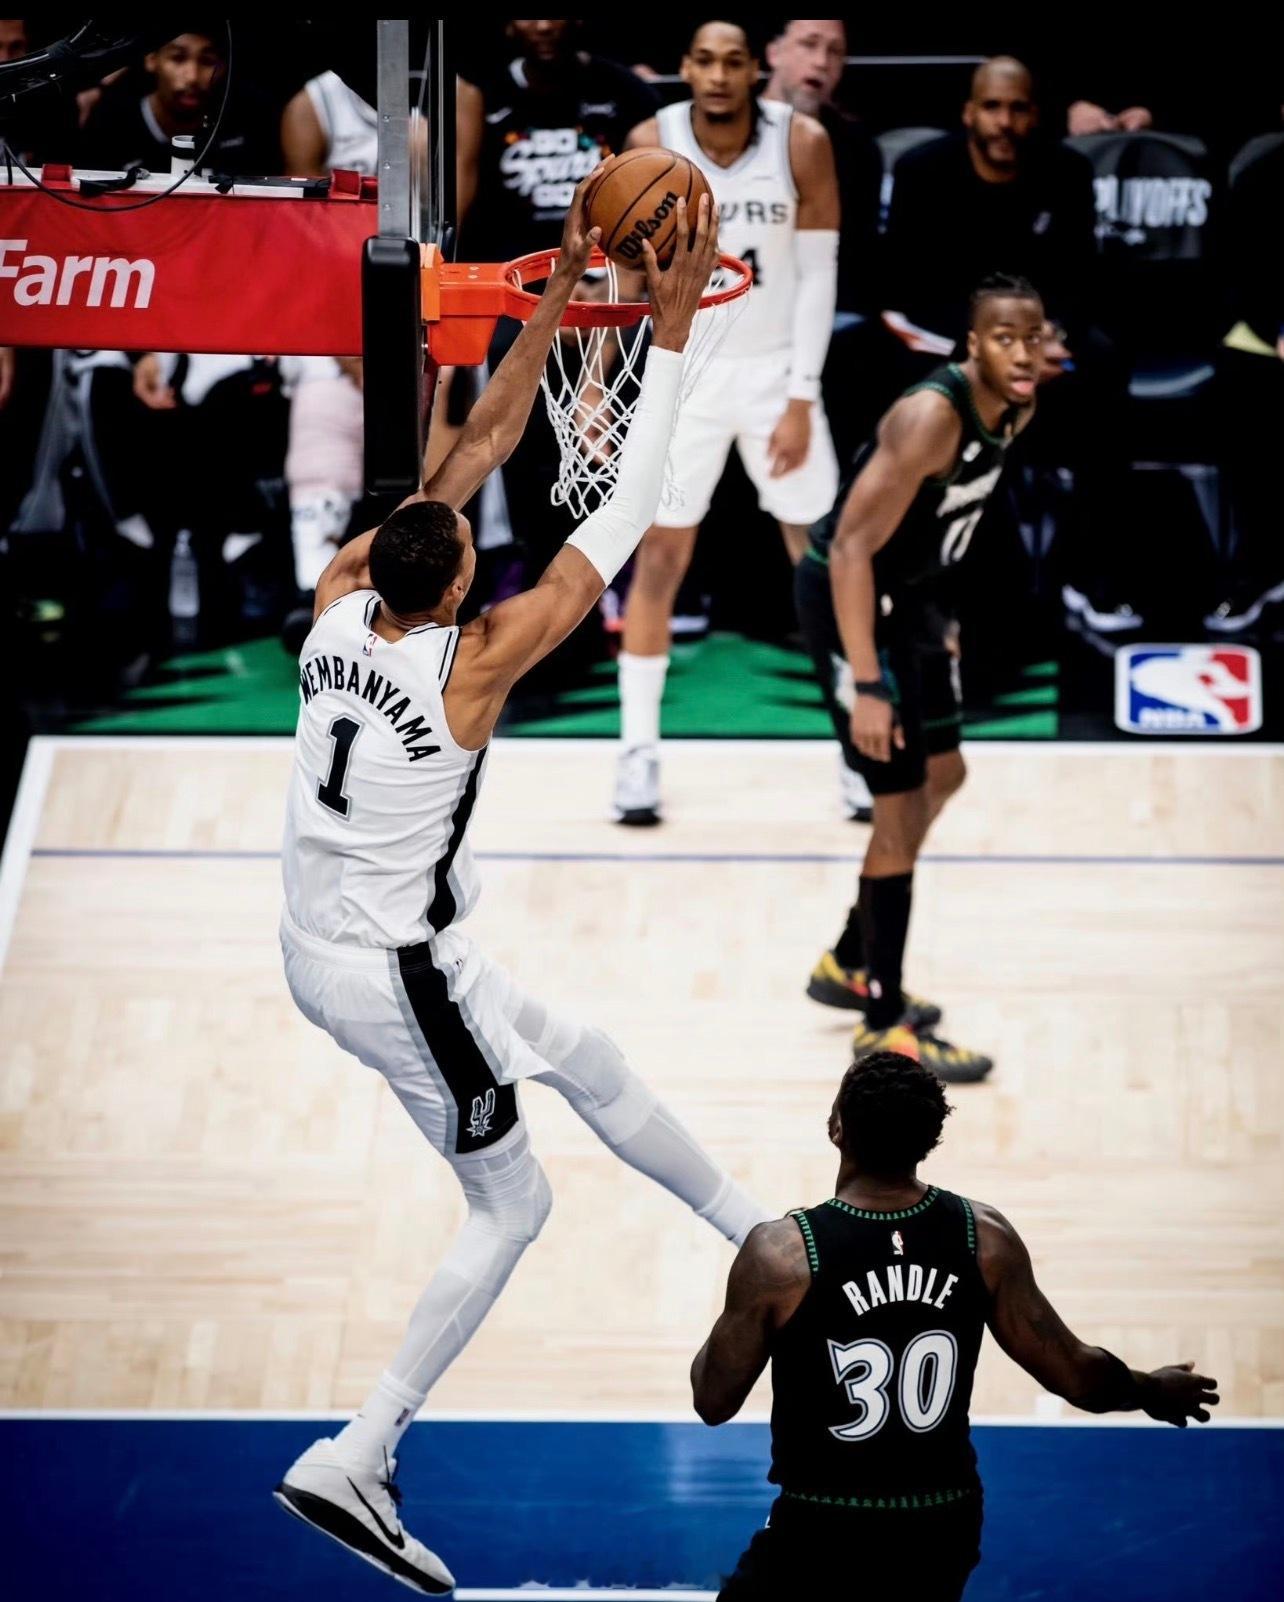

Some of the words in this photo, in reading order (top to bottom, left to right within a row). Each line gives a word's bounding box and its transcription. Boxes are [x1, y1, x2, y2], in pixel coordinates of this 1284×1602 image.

[617, 191, 680, 260] Wilson
[718, 201, 789, 224] URS
[0, 239, 156, 309] Farm
[300, 655, 442, 762] WEMBANYAMA
[315, 712, 366, 823] 1
[841, 1264, 960, 1317] RANDLE
[826, 1329, 959, 1442] 30
